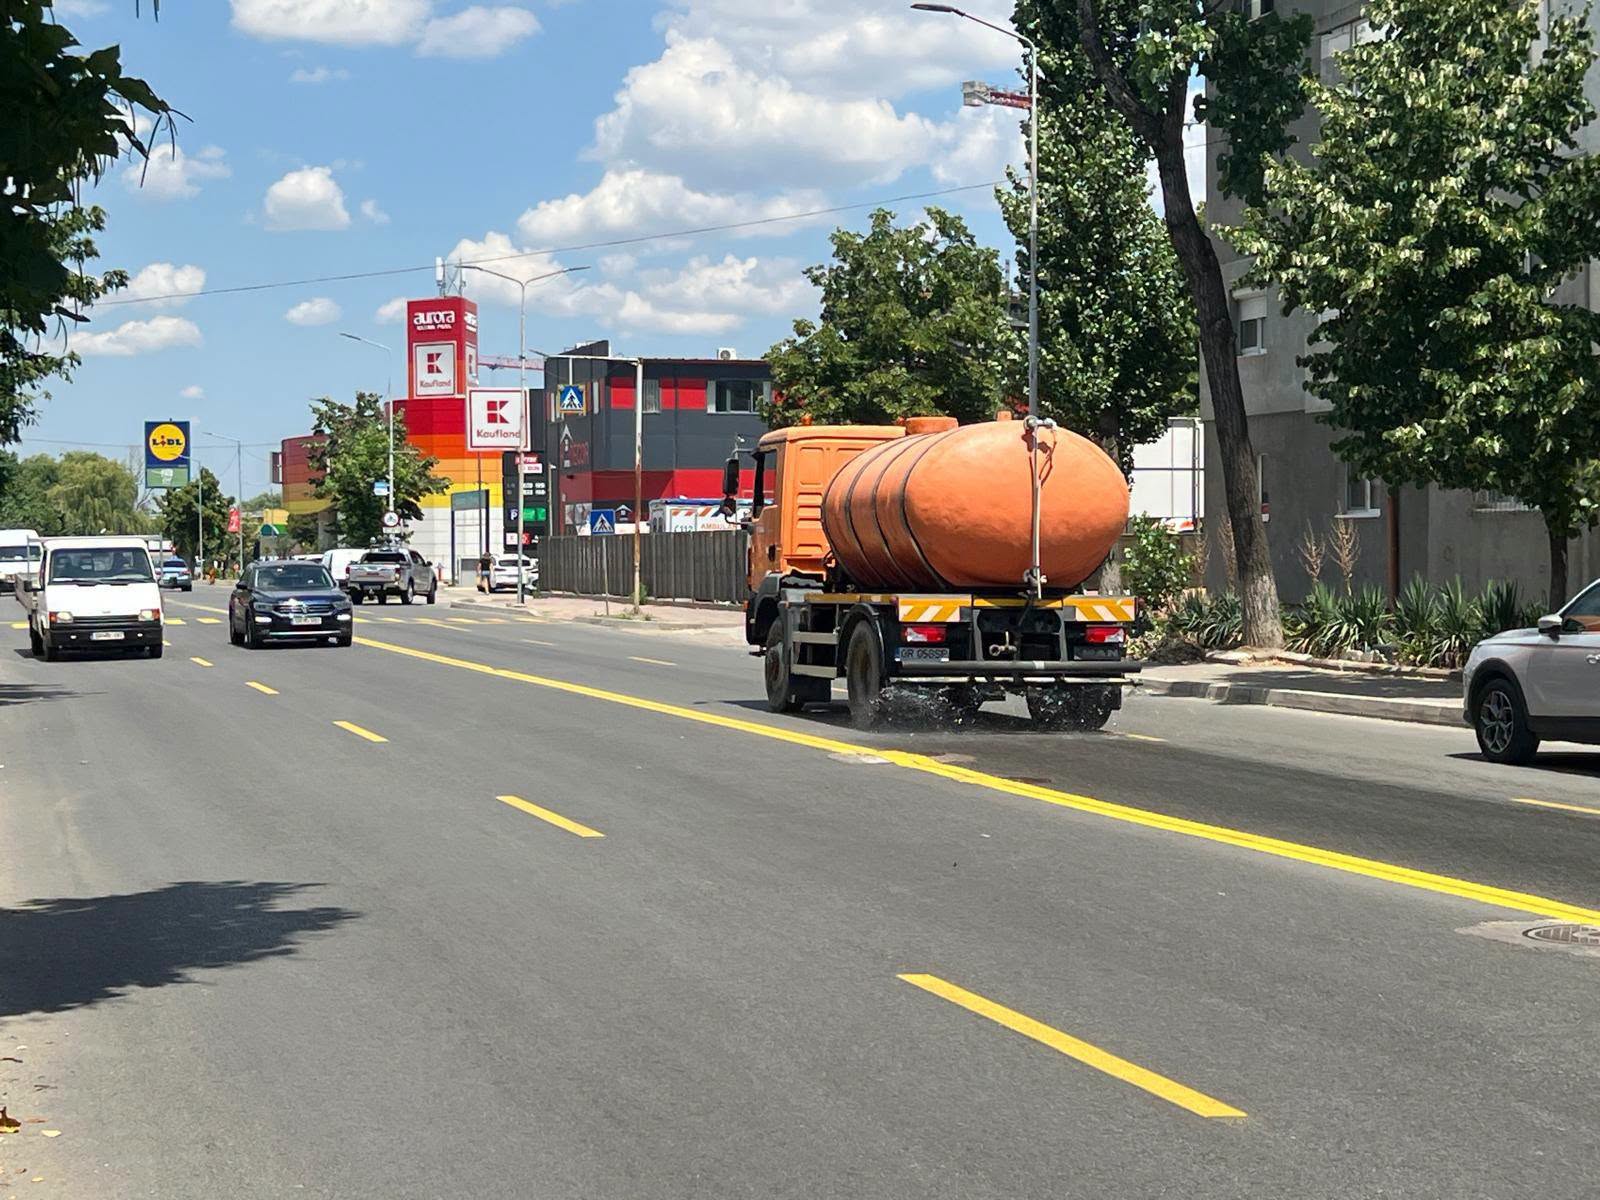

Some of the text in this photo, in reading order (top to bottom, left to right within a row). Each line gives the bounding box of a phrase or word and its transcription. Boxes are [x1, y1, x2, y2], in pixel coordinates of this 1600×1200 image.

[413, 310, 456, 325] aurora
[420, 380, 452, 388] Kaufland
[476, 429, 521, 438] Kaufland
